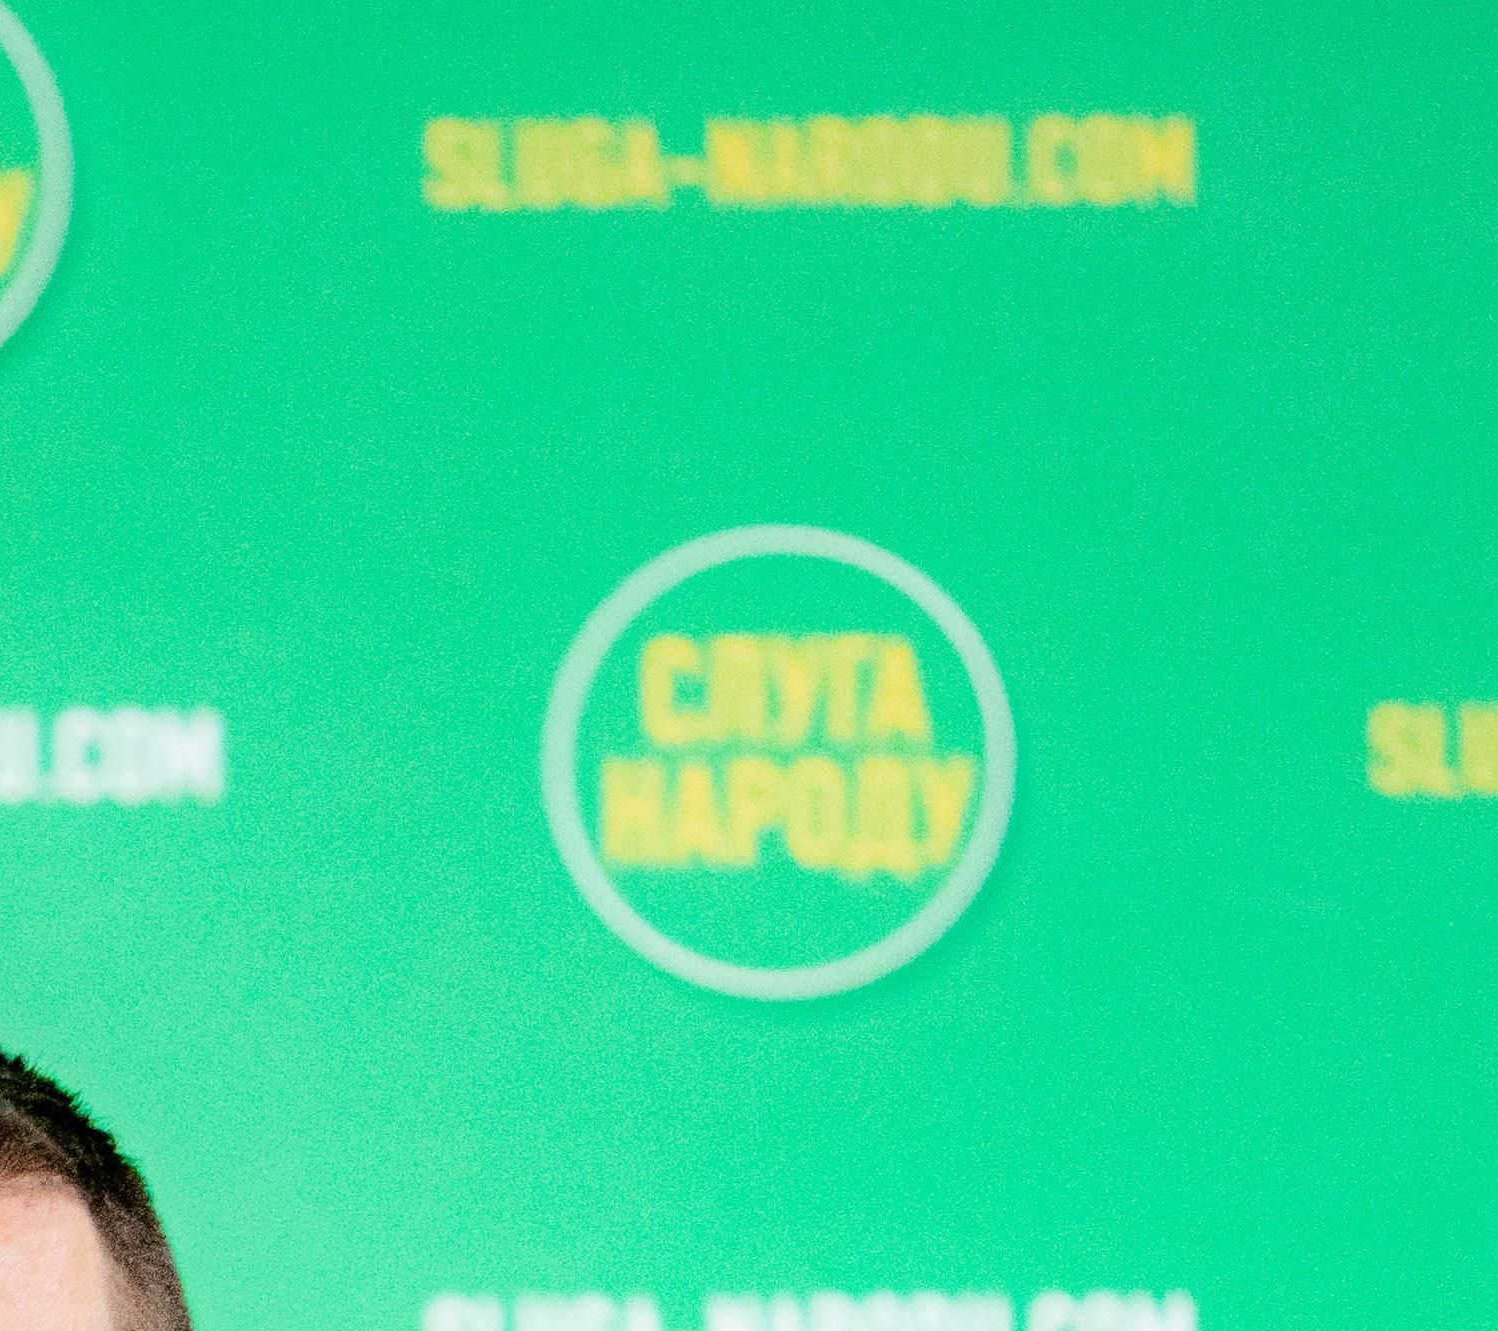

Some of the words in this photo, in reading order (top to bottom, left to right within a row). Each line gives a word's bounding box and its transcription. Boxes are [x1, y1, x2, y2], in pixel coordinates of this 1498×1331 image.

[422, 113, 1197, 211] SLUGA-NARODU.COM
[638, 633, 931, 746] СЛУГА
[598, 747, 978, 879] НАРОДУ
